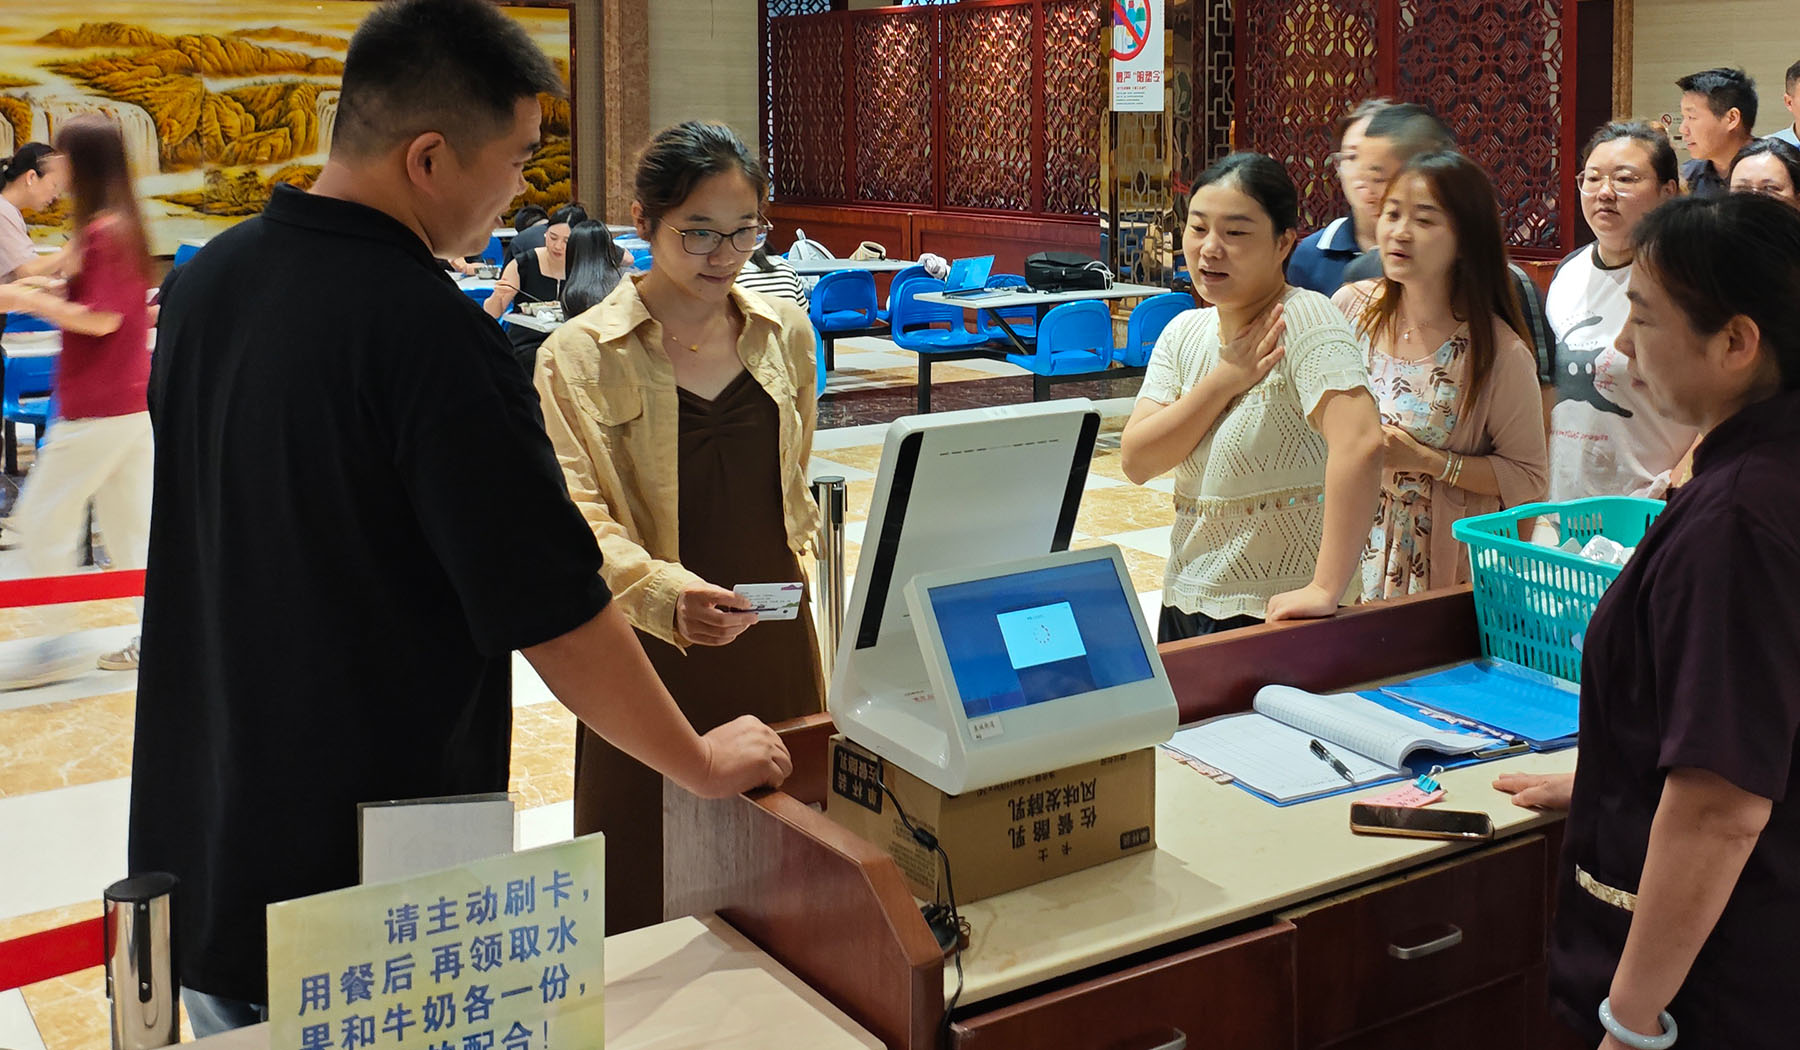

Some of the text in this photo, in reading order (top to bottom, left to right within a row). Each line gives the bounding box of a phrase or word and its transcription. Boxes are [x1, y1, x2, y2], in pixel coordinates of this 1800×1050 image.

[1008, 777, 1097, 823] 风味发酵乳
[1008, 805, 1098, 850] 佐餐酪乳
[1037, 841, 1073, 863] 卡士
[384, 869, 590, 945] 请主动刷卡，
[298, 915, 579, 1016] 用餐后再领取水
[300, 962, 587, 1050] 果和牛奶各一份，
[428, 1020, 549, 1050] 配合！
